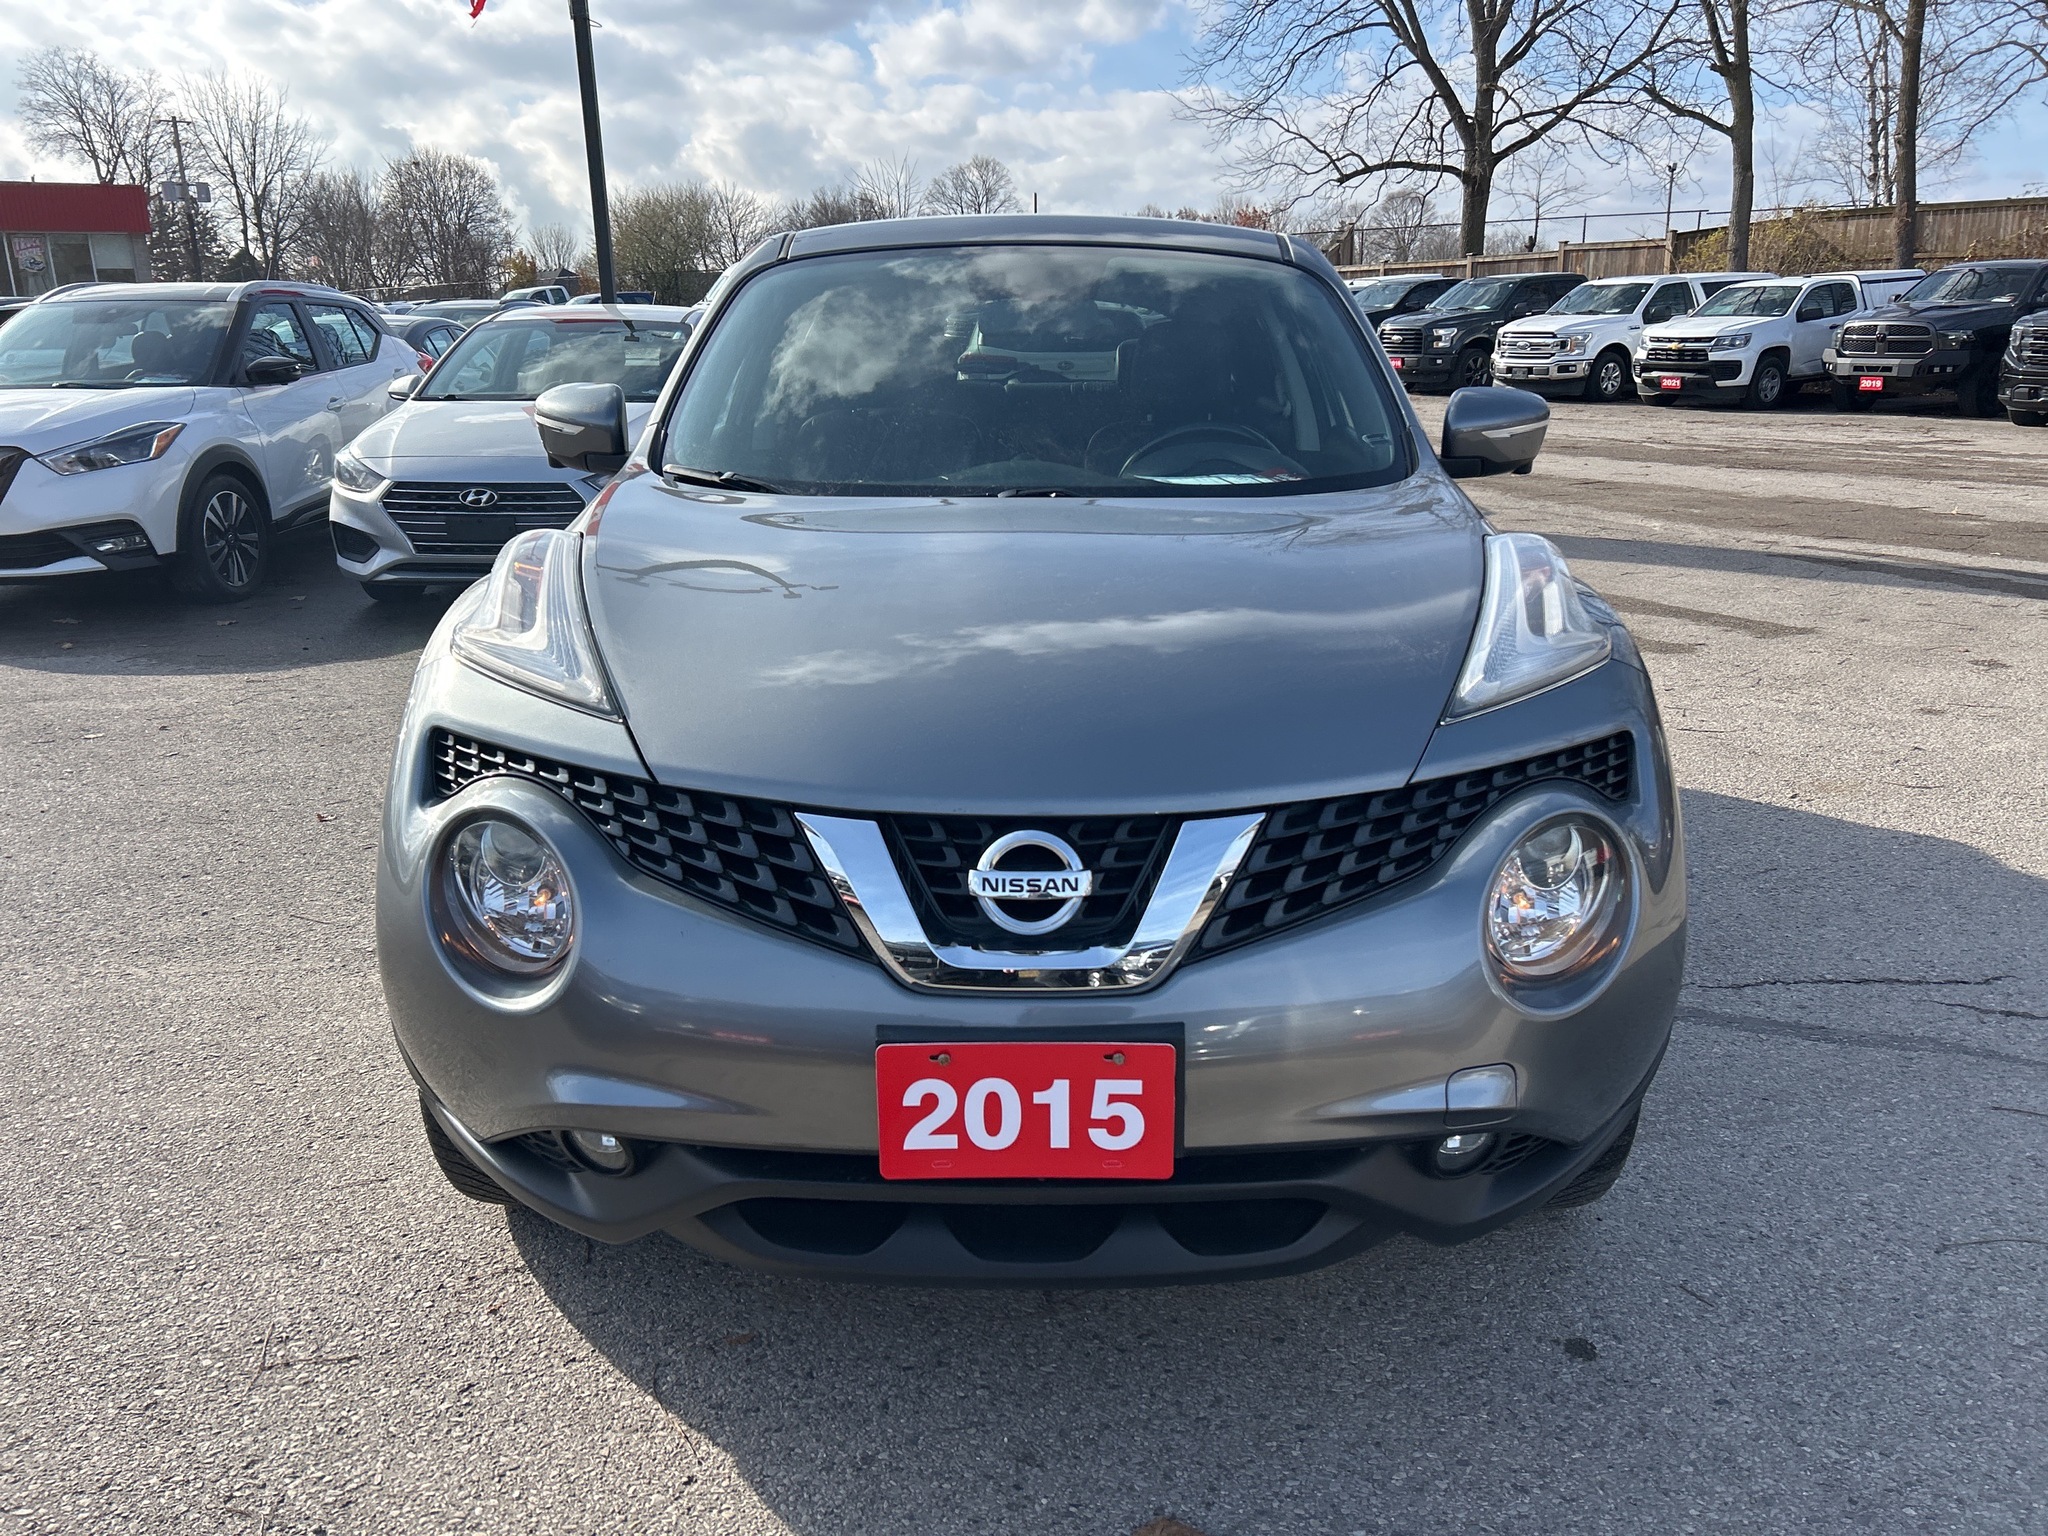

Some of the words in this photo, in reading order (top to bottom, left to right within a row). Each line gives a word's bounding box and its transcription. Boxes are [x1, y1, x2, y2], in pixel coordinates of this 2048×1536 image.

[1662, 379, 1680, 387] 2021
[1861, 379, 1881, 388] 2019
[982, 877, 1079, 893] NISSAN
[902, 1077, 1145, 1150] 2015
